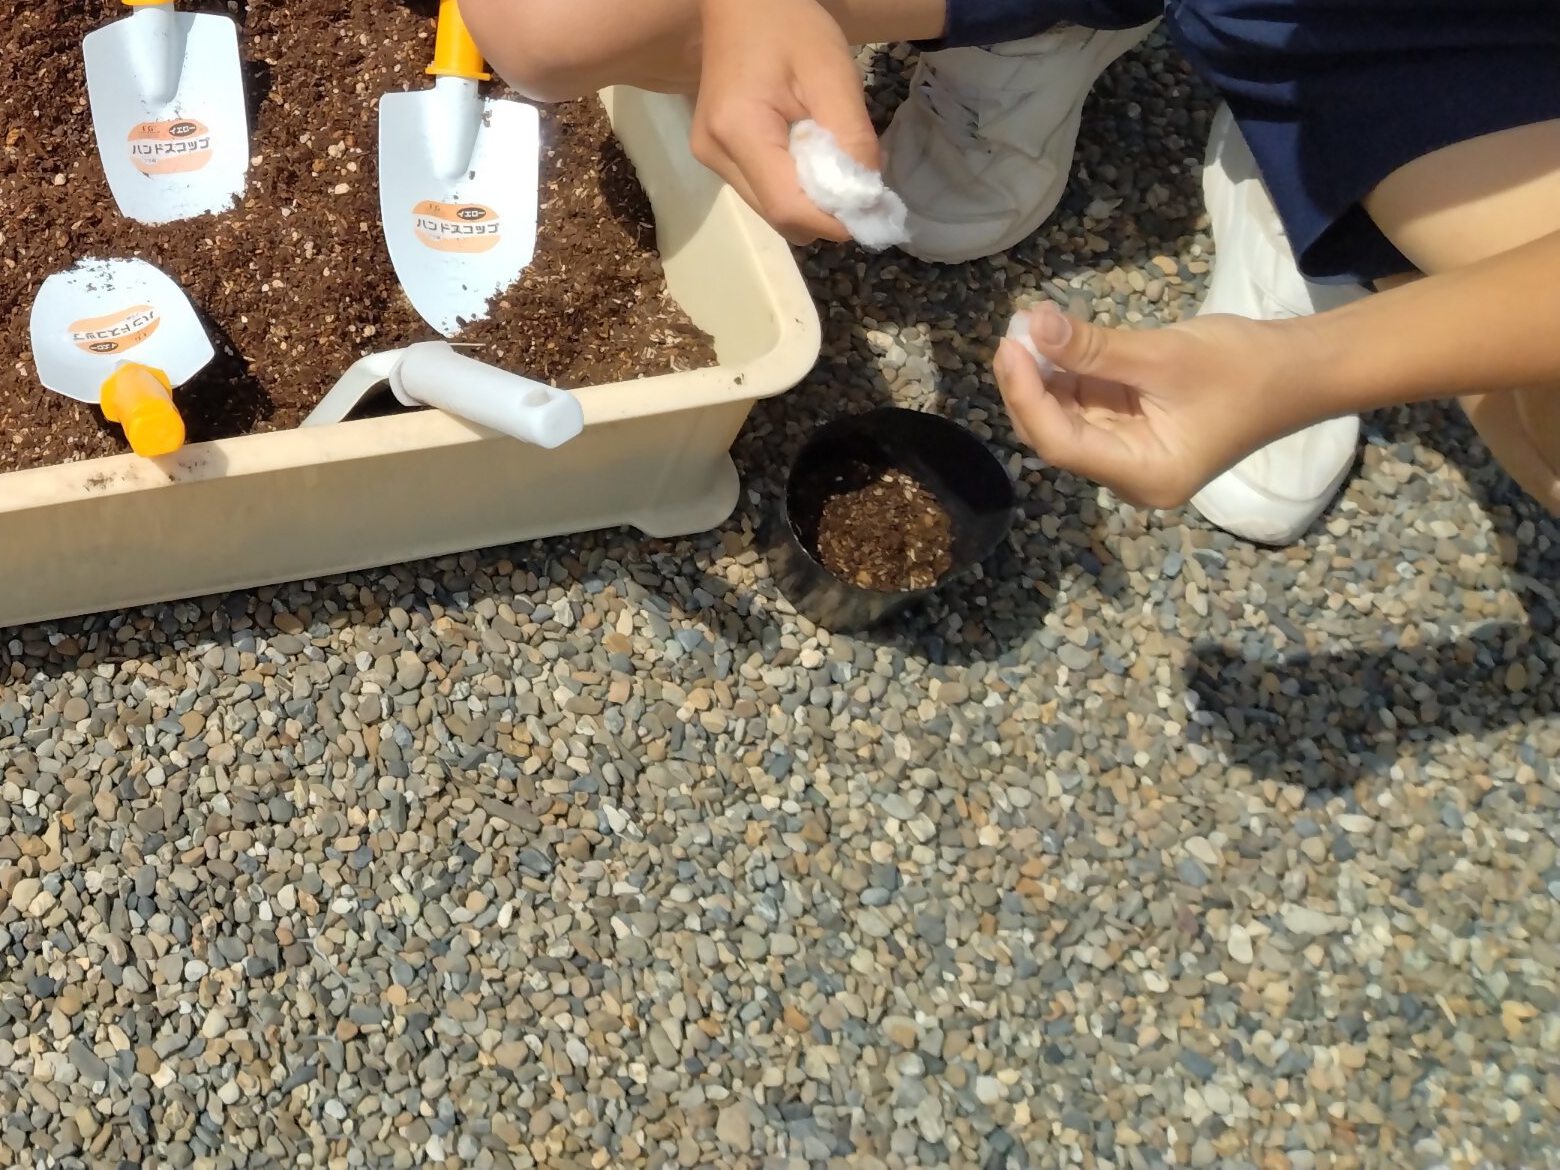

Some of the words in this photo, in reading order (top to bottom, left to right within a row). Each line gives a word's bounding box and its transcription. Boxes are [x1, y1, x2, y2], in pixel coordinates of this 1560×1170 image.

[169, 125, 197, 135] イエロー
[131, 136, 211, 155] ハンドスコップ
[457, 209, 487, 218] イエロー
[416, 218, 500, 235] ハンドスコップ
[72, 310, 155, 342] ハンドスコップ
